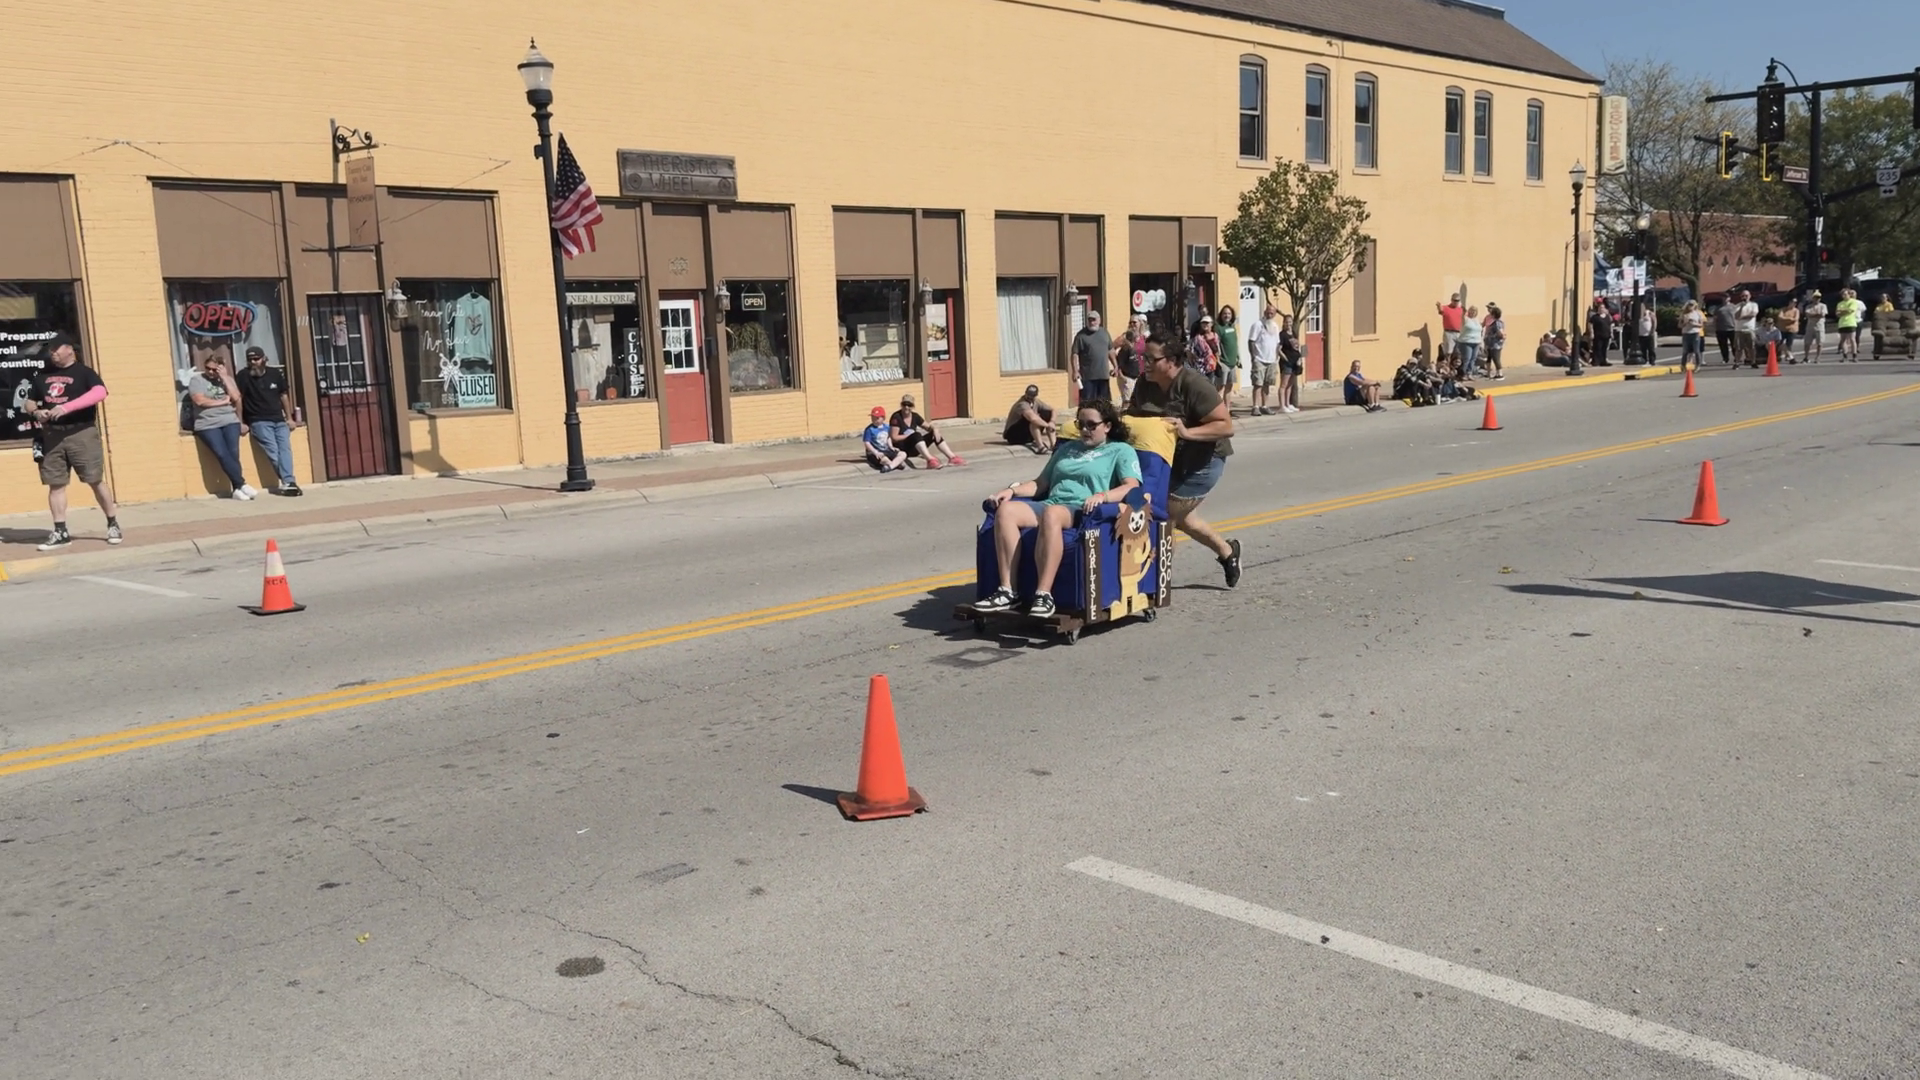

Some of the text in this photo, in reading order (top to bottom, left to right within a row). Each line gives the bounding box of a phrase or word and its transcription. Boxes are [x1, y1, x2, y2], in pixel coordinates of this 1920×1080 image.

[649, 173, 699, 193] WHEEL
[1878, 171, 1898, 183] 235
[568, 294, 632, 303] NERAL STORE
[744, 297, 764, 307] OPEN
[185, 303, 252, 333] OPEN
[0, 359, 45, 369] ounting
[628, 331, 641, 397] CLOSED
[874, 368, 904, 382] STORE
[458, 375, 495, 397] CLOSED
[1085, 528, 1100, 540] NEW
[1159, 521, 1167, 607] TROOP
[1088, 538, 1097, 620] CARLISLE
